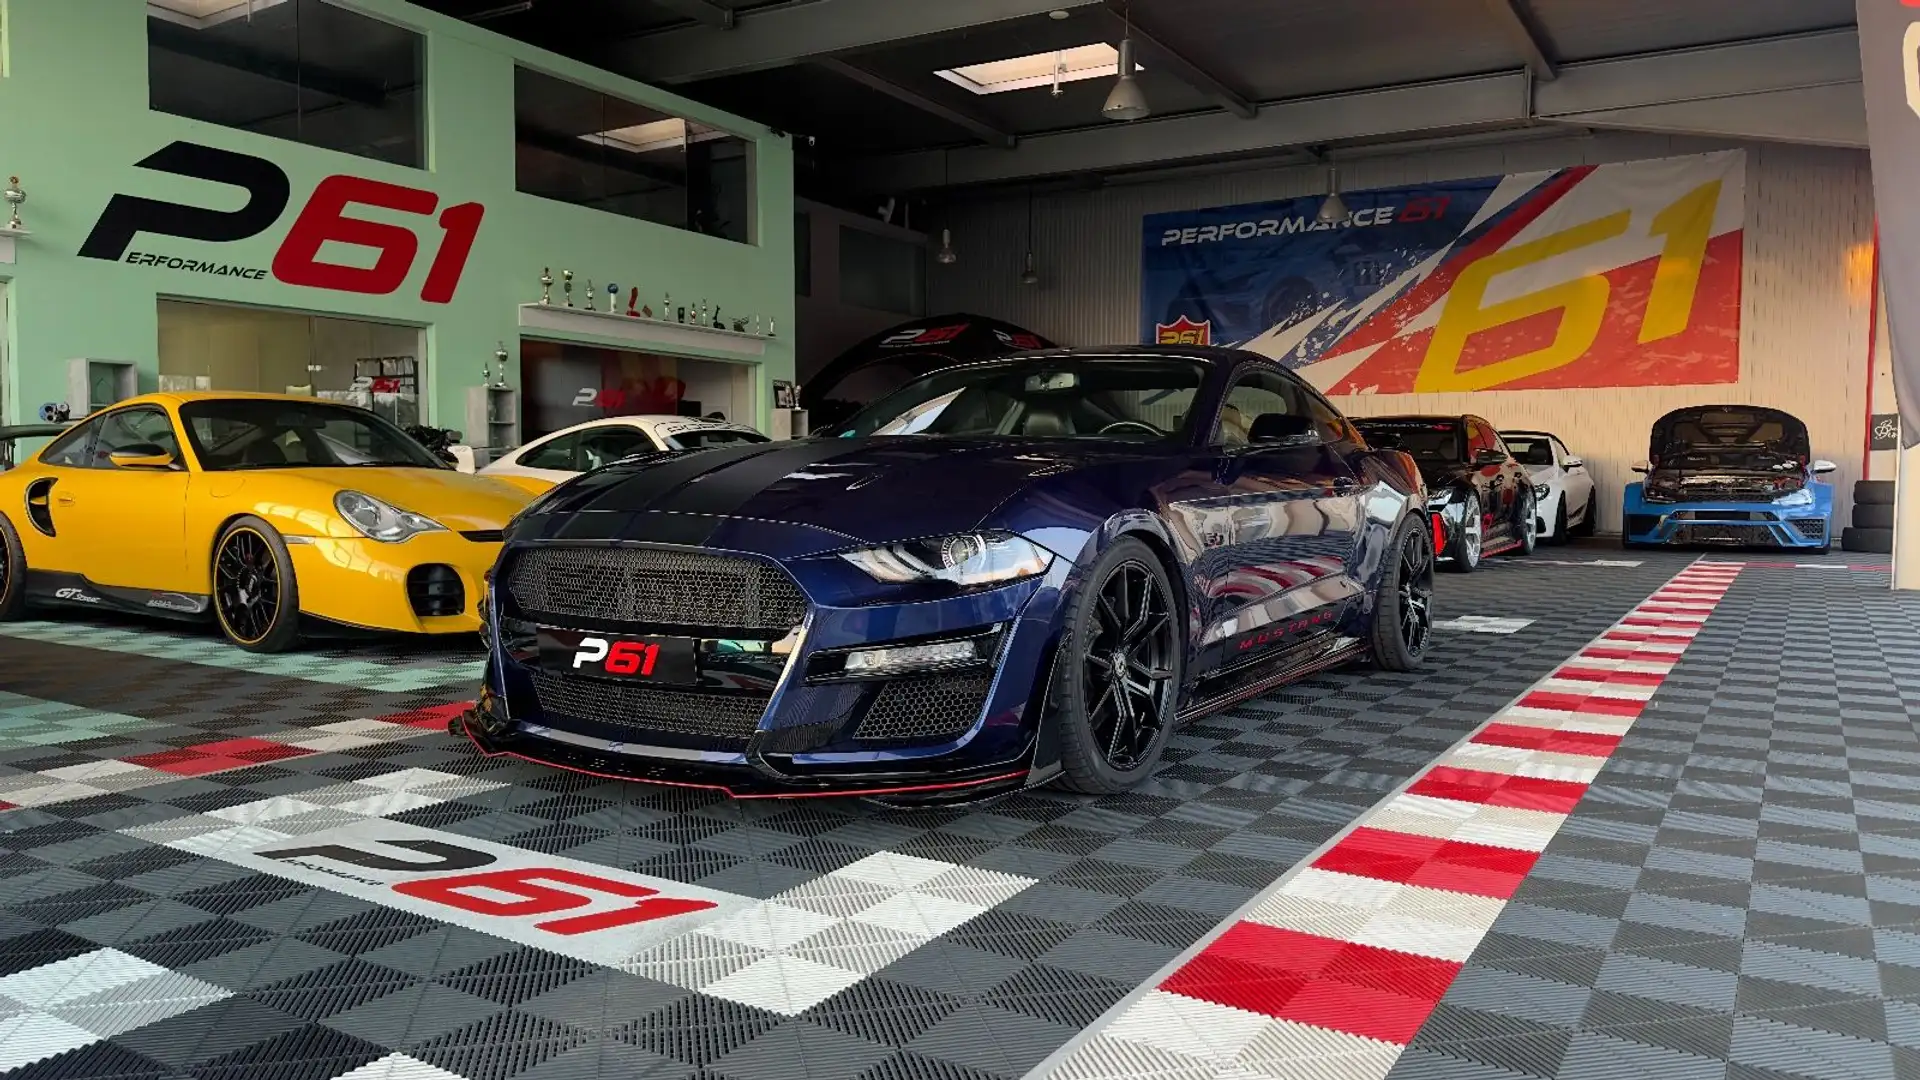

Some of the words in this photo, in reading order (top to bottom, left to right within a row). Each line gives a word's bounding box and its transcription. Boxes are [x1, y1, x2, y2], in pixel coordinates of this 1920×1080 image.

[77, 140, 485, 304] P61
[1398, 196, 1451, 222] 61
[1413, 180, 1722, 392] 61
[572, 637, 660, 675] P61
[1239, 608, 1333, 649] MUSTANG
[253, 839, 719, 936] P61
